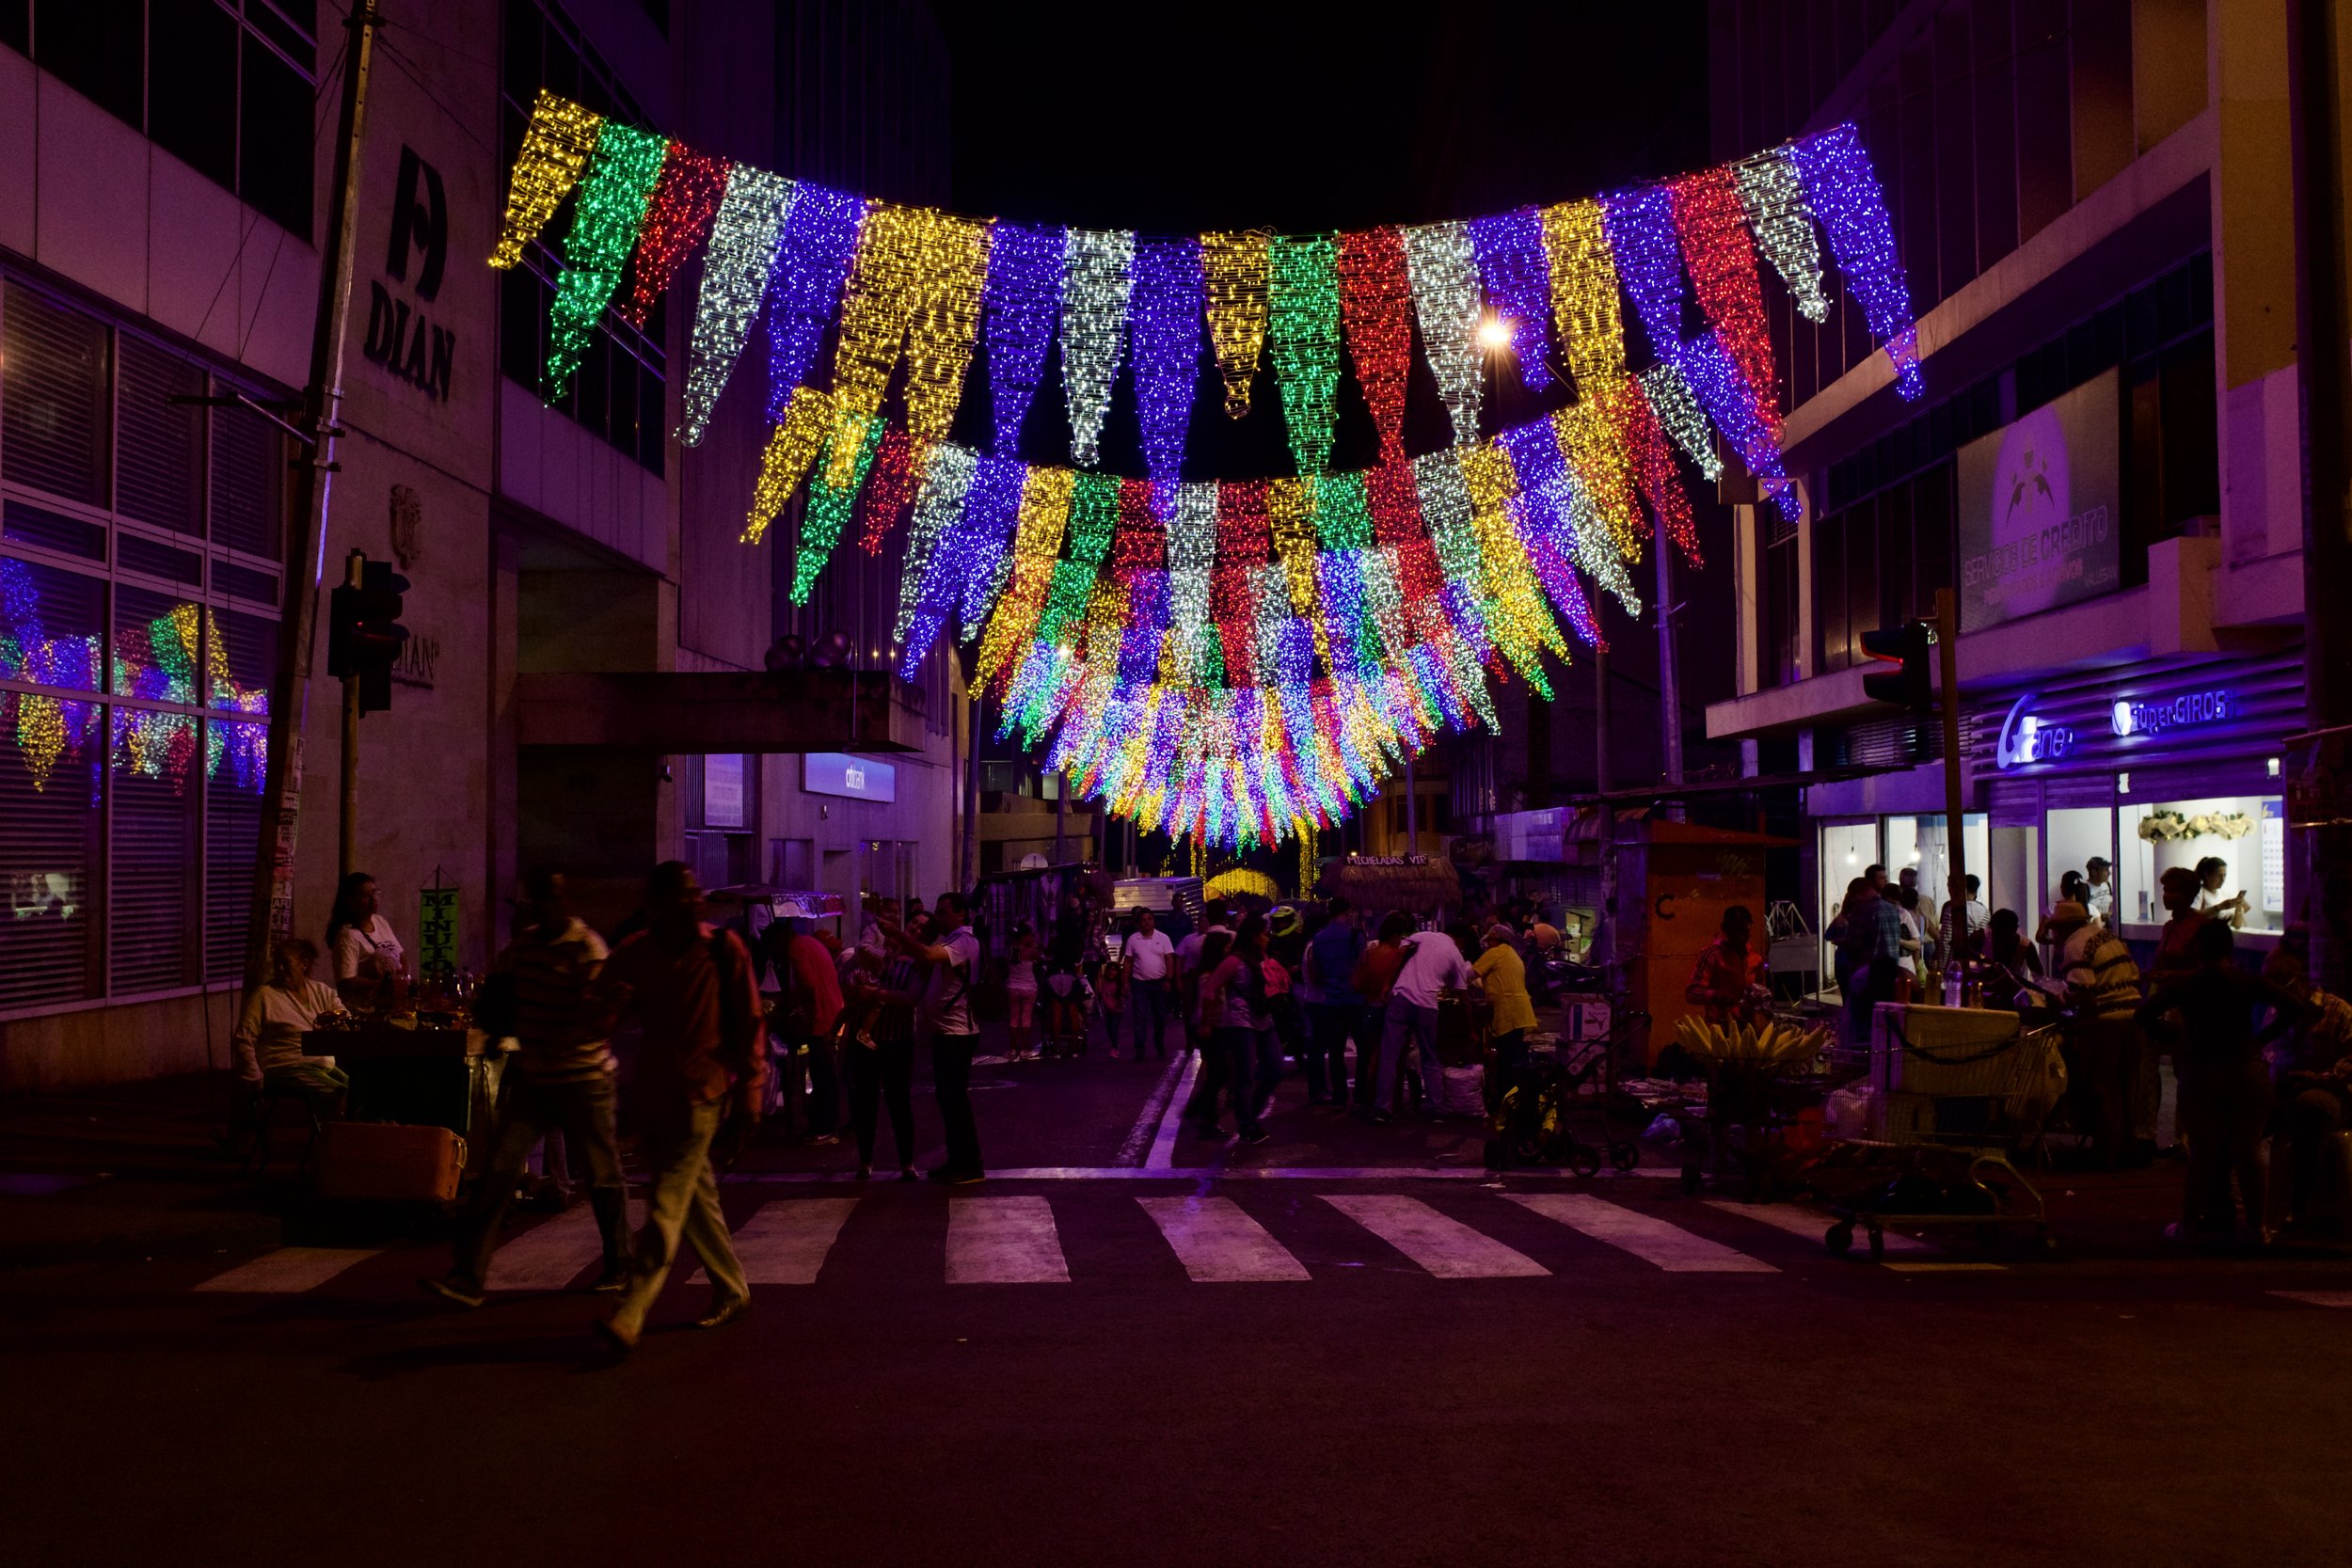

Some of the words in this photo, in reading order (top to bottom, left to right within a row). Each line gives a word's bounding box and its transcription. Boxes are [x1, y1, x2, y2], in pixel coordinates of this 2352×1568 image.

[364, 280, 455, 403] DIAN
[2022, 532, 2038, 568] DE
[2040, 505, 2108, 562] CREDITO
[1346, 855, 1405, 865] MICHELADAS
[1408, 855, 1427, 864] VIP
